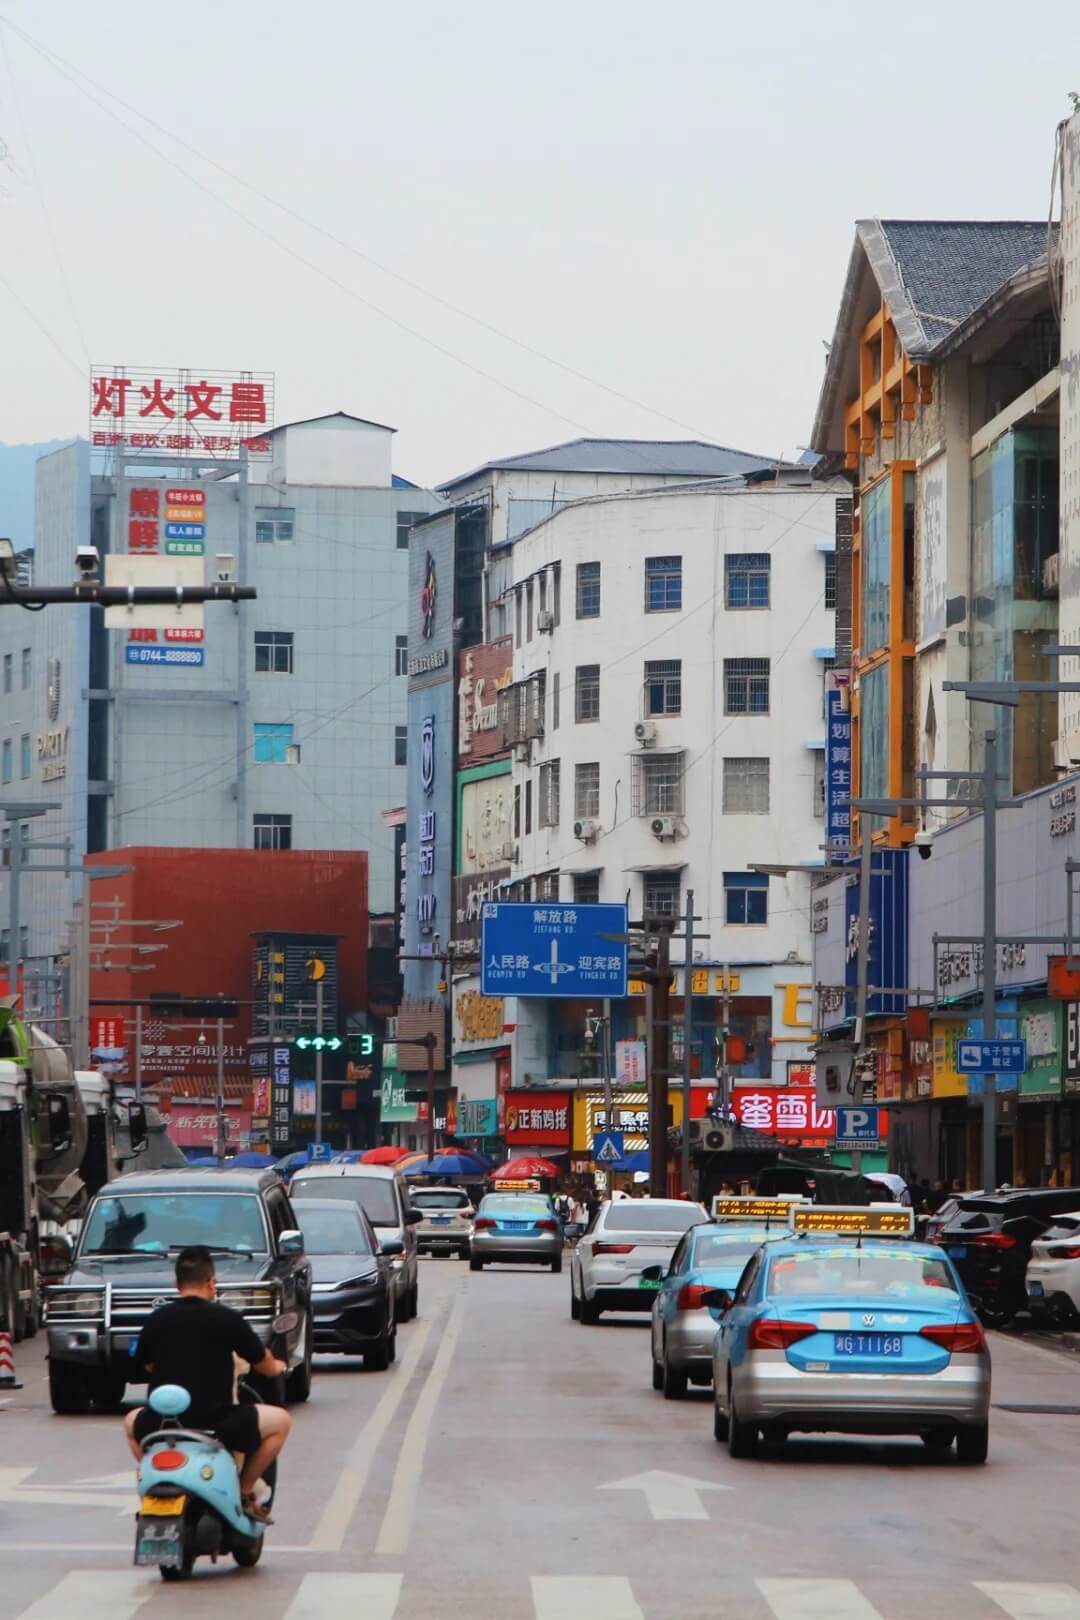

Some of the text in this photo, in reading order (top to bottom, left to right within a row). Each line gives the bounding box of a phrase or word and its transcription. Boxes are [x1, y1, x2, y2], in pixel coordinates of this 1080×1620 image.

[92, 377, 267, 423] 灯火文昌
[533, 910, 577, 924] 解放路
[487, 955, 530, 970] 人民路
[578, 955, 622, 971] 迎宾路
[361, 1035, 373, 1055] 3
[518, 1107, 568, 1130] 正新鸡排
[843, 1110, 869, 1137] P
